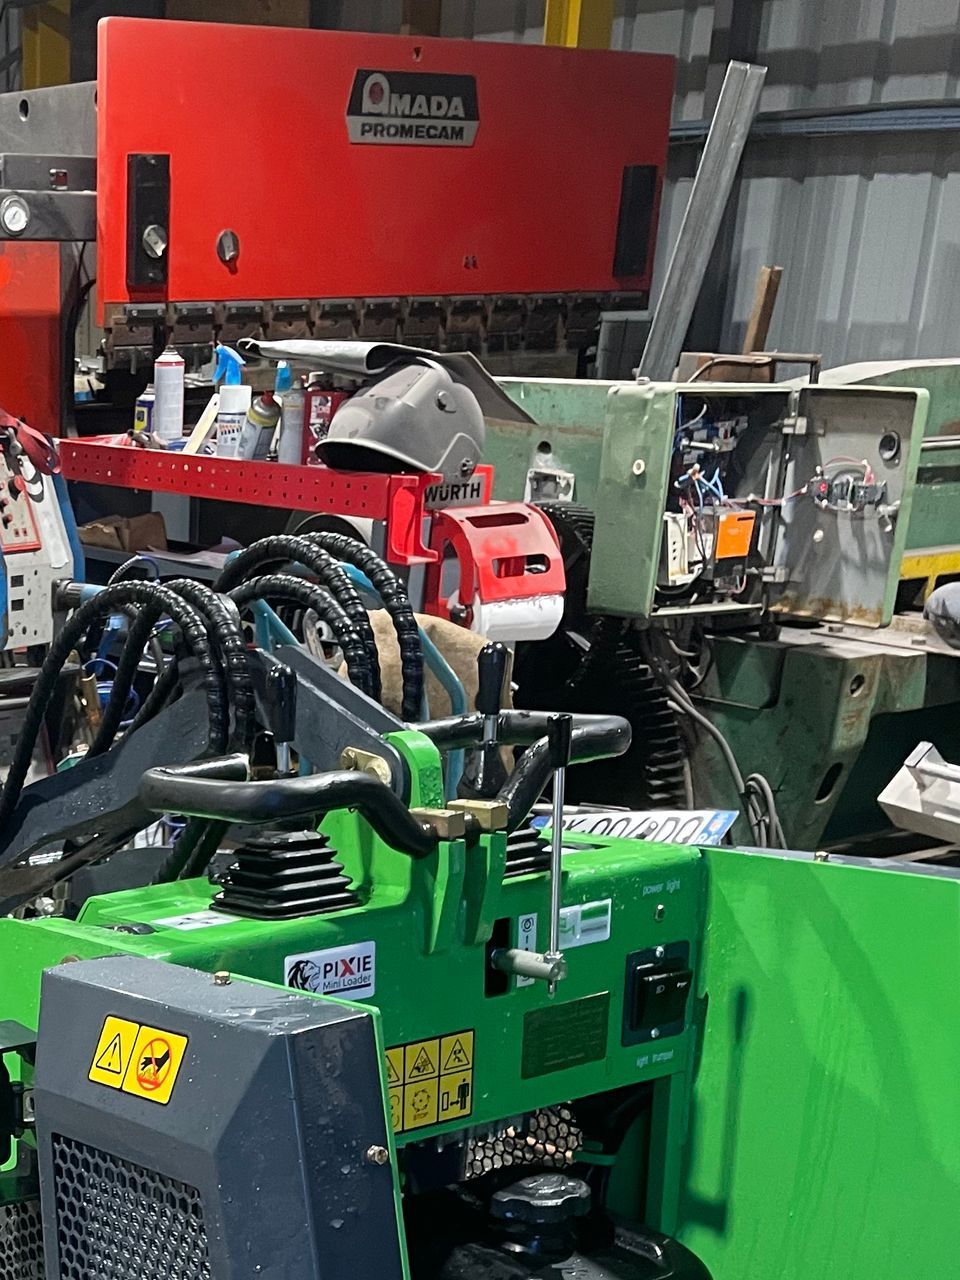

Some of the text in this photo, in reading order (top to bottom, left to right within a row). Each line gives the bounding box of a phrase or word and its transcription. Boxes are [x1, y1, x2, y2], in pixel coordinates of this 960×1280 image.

[361, 122, 465, 141] PROMECAM
[424, 482, 481, 503] WÜRTH
[323, 954, 372, 980] PIXIE
[323, 974, 372, 991] Mini Loader
